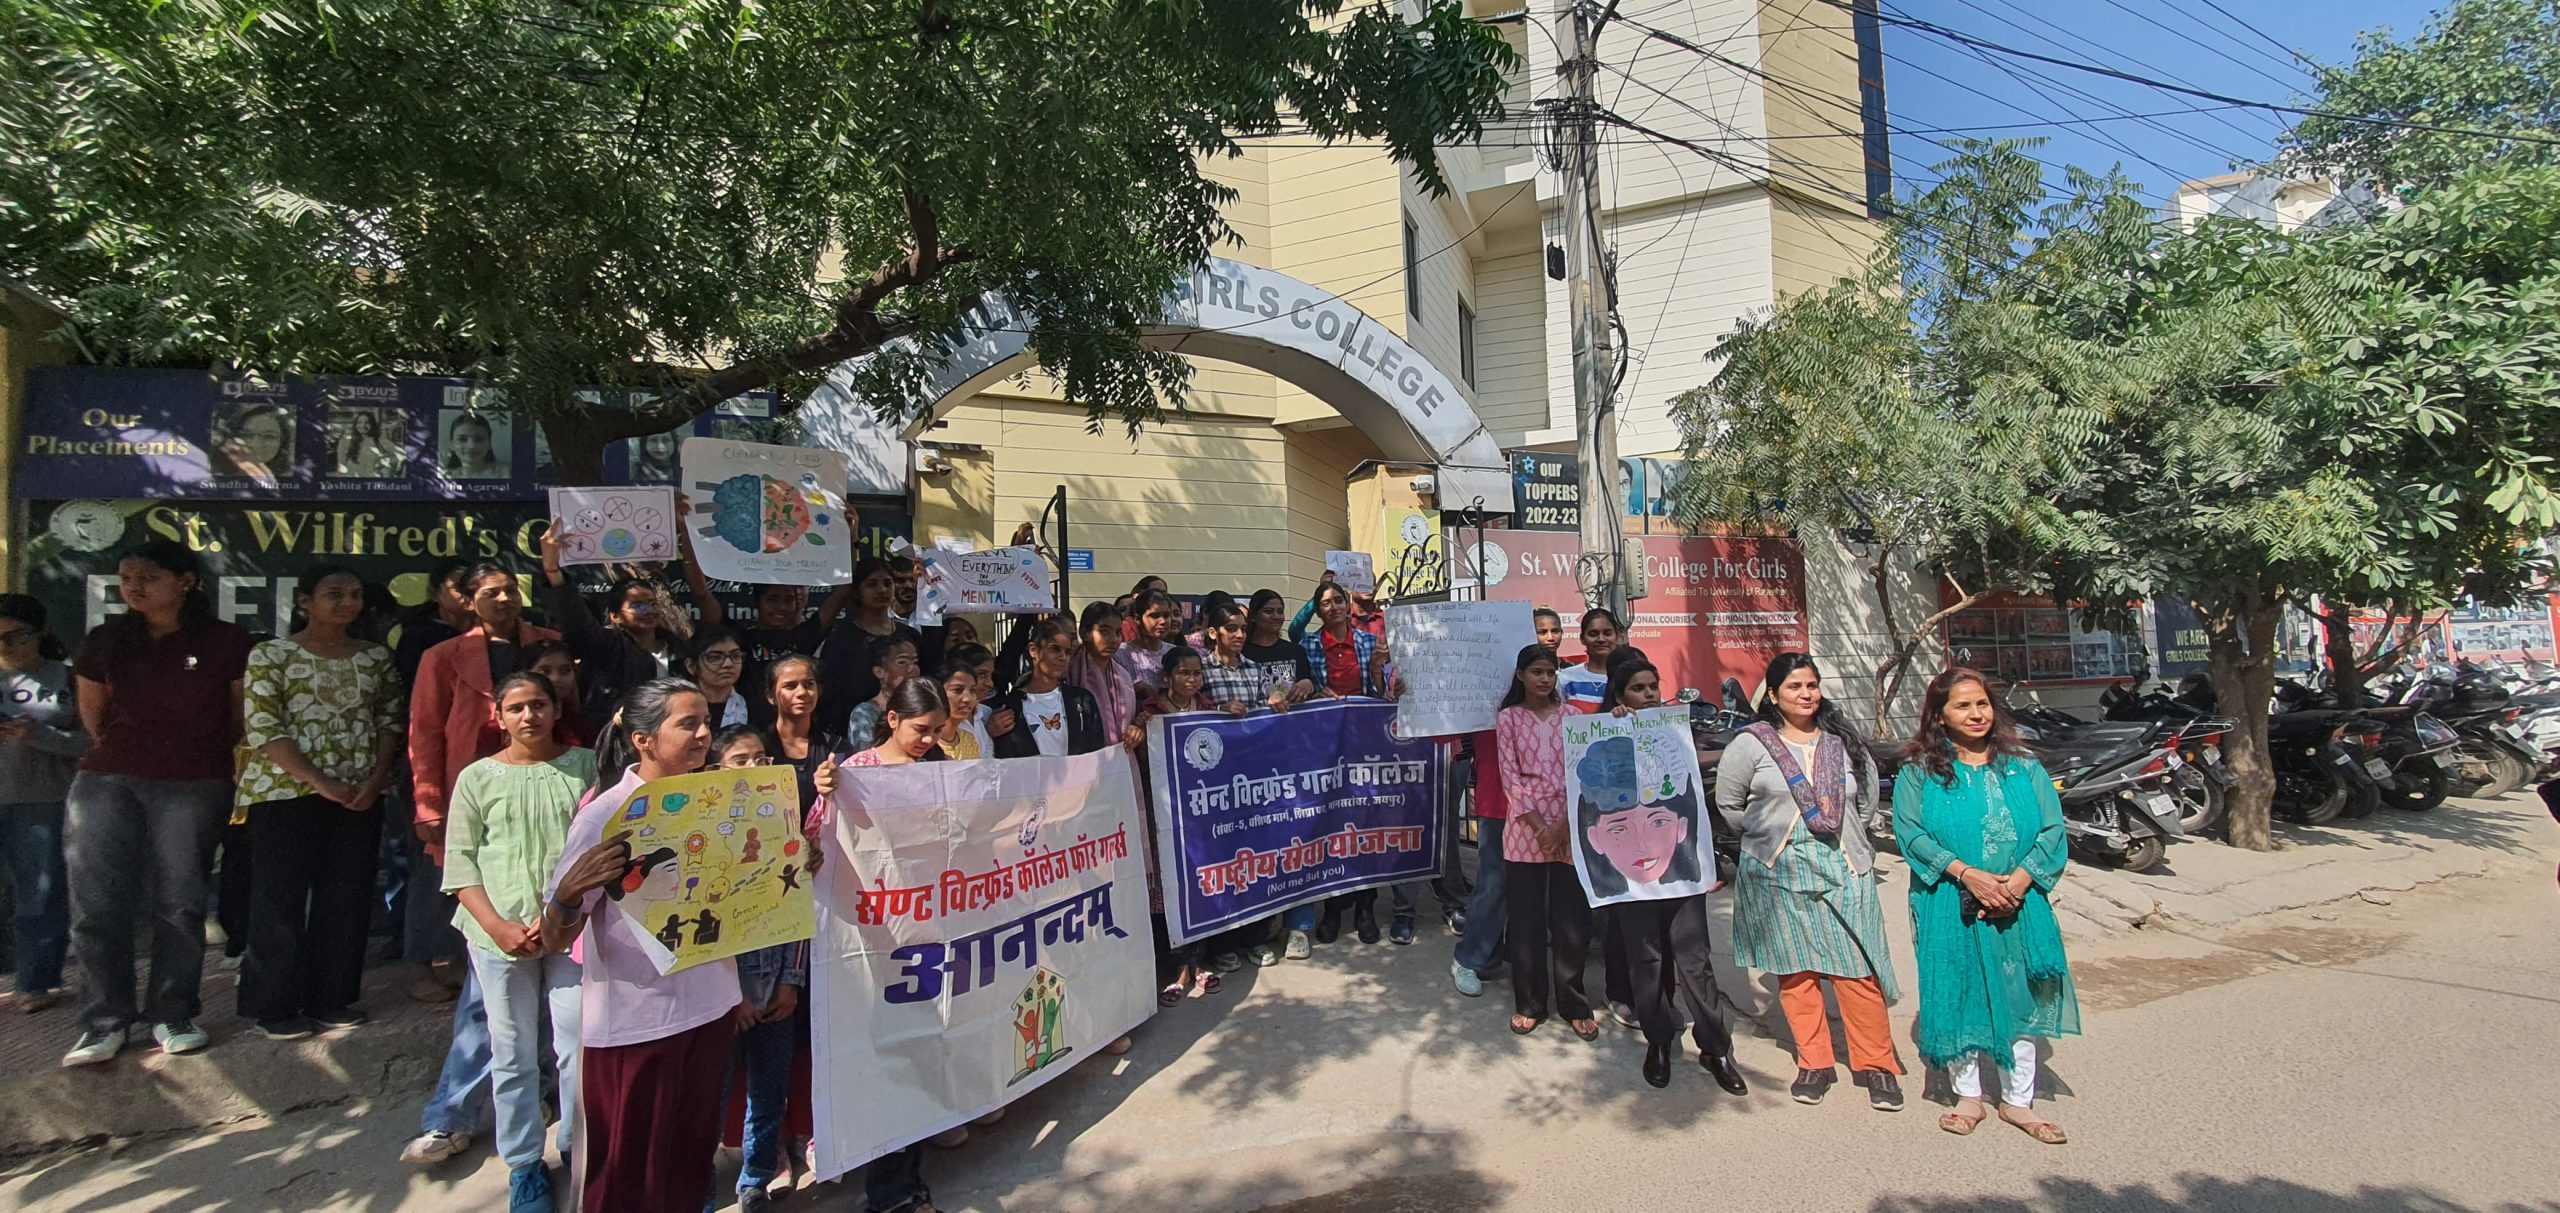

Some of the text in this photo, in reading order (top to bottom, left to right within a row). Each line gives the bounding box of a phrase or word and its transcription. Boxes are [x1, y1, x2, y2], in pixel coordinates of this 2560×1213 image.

[1290, 298, 1445, 418] COLLEGE
[355, 386, 399, 396] BYJU'S
[82, 408, 142, 429] Our
[28, 435, 190, 456] Placements
[465, 482, 510, 491] Agarwal
[1524, 482, 1579, 501] TOPPERS
[1525, 506, 1578, 525] 2022-23
[146, 506, 223, 552] St.
[243, 510, 499, 558] Wilfred's
[1520, 552, 1547, 576] St.
[1646, 555, 1708, 584] College
[1712, 557, 1743, 579] For
[1747, 557, 1788, 579] Girls
[961, 589, 1010, 604] MENTAL
[1665, 587, 1697, 597] Affiliated
[1700, 587, 1709, 597] To
[1659, 615, 1691, 624] COURSES
[1712, 613, 1793, 625] FASHION TECHNOLOGY
[1628, 629, 1662, 639] Graduate
[1565, 726, 1589, 745] YOUR
[1590, 721, 1633, 739] MENTAL
[1348, 754, 1427, 787] कॉलेज
[1280, 836, 1325, 873] सेवा
[1327, 822, 1425, 858] योजना
[855, 878, 934, 926] सेण्ट
[939, 858, 1014, 914] विल्फ्रेड
[1017, 848, 1069, 893] कॉलेज
[1068, 832, 1098, 874] फॉर
[1267, 878, 1288, 896] (Not
[1305, 873, 1320, 885] But
[1322, 864, 1345, 880] you)
[884, 881, 1129, 1005] आनन्दम्
